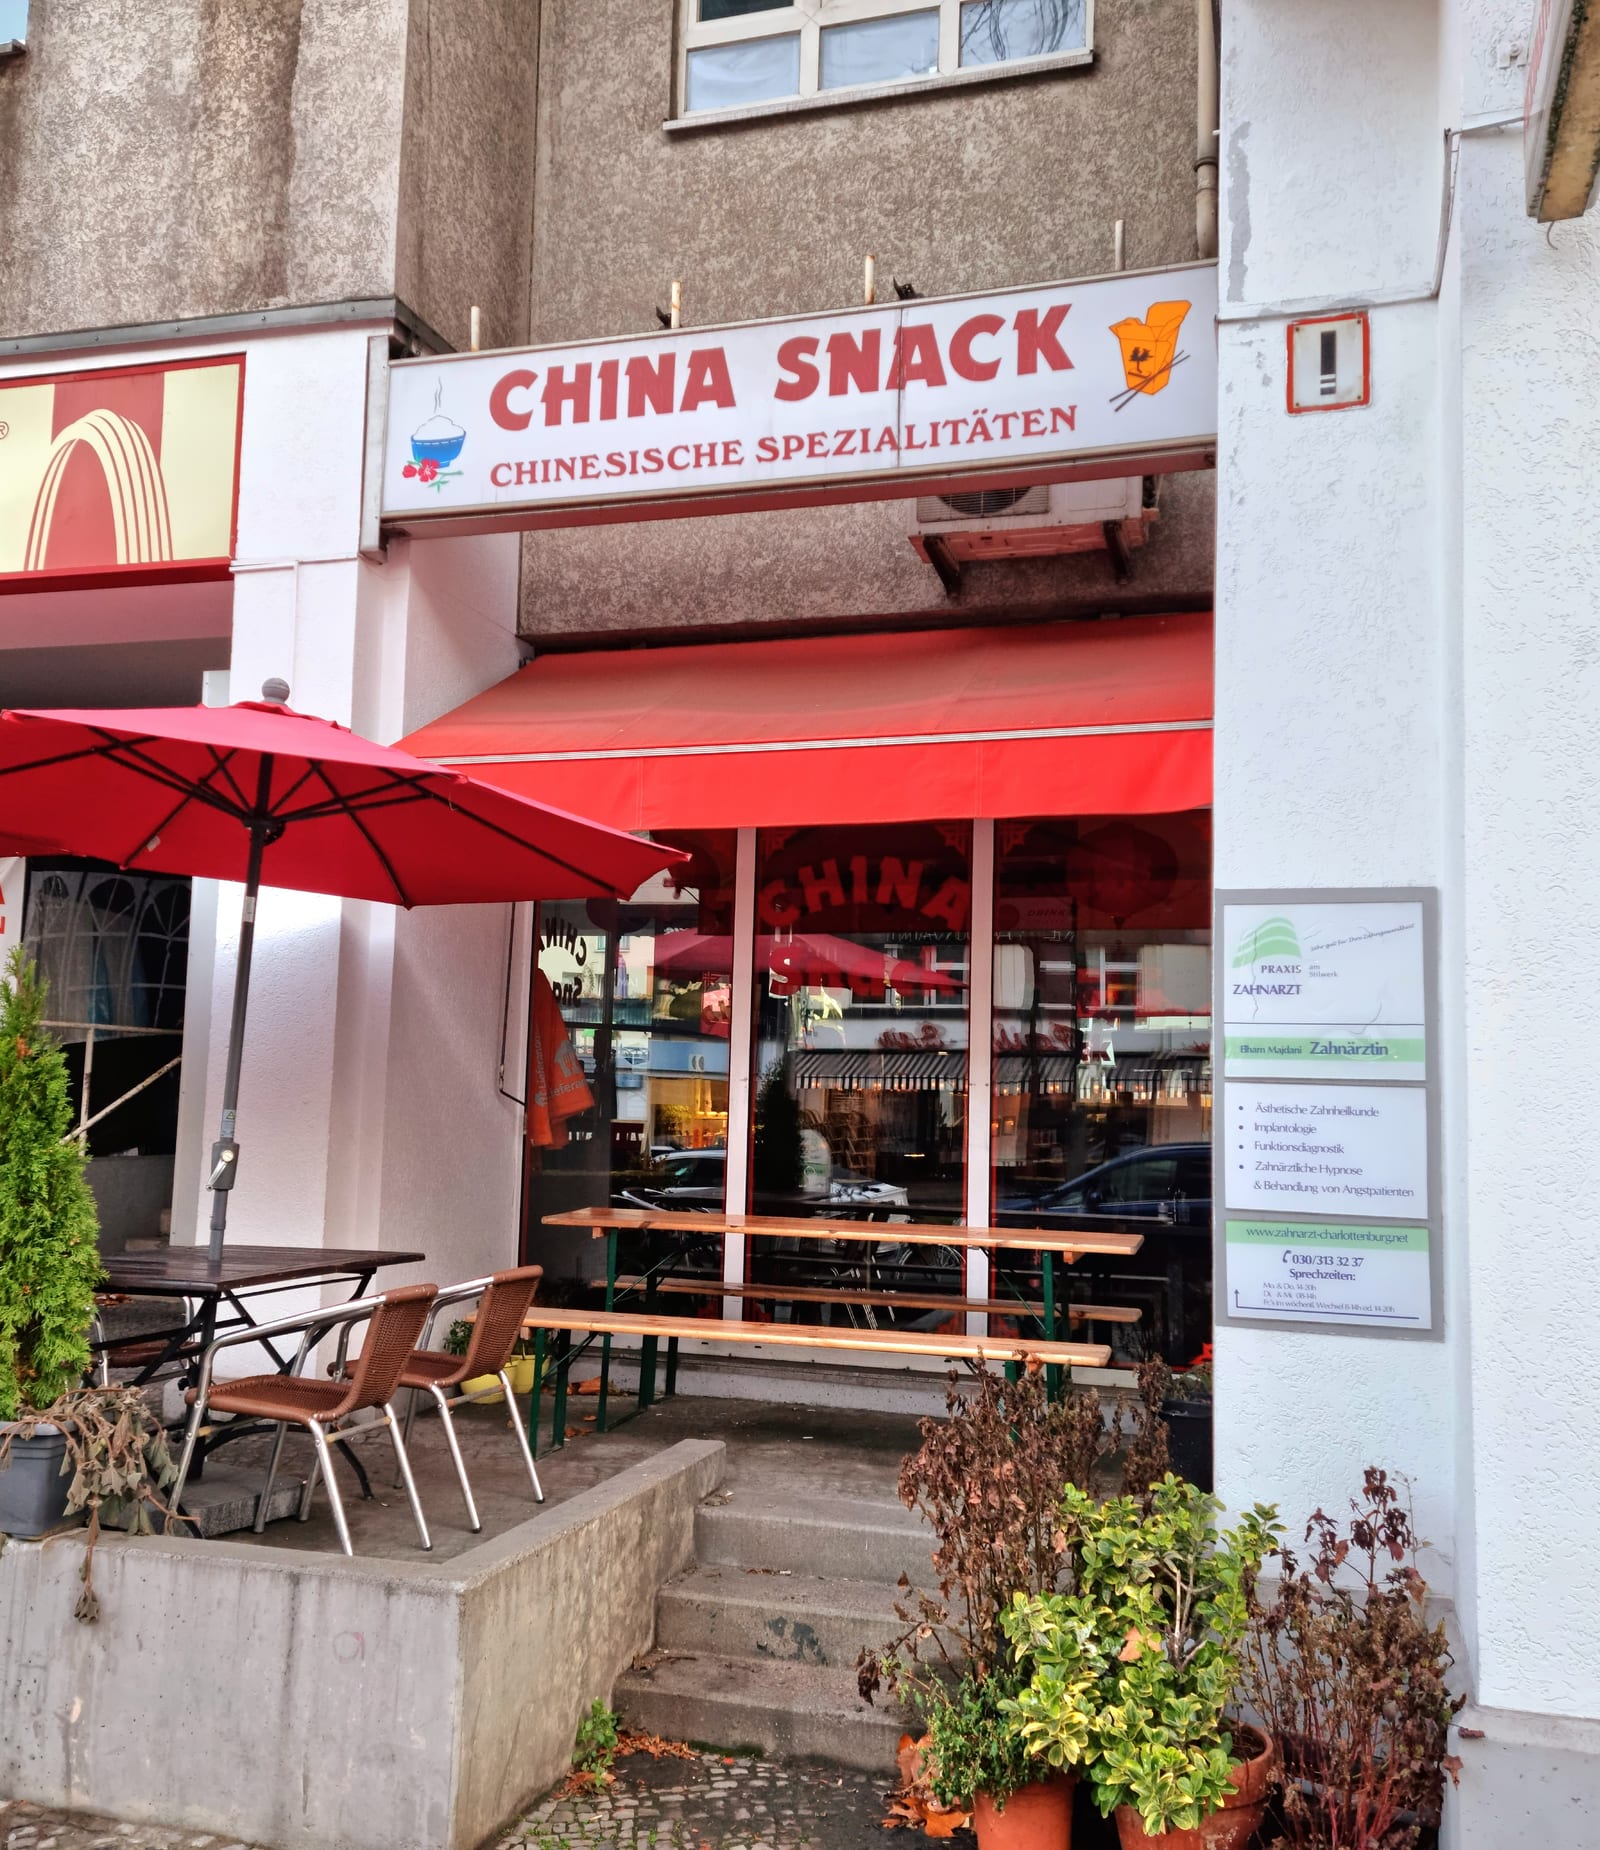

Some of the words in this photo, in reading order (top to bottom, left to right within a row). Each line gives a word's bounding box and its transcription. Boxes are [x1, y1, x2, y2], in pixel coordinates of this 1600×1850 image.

[488, 346, 737, 432] CHINA
[774, 303, 1076, 403] SNACK
[489, 439, 745, 488] CHINESISCHE
[755, 405, 1078, 463] SPEZIALITÄTEN
[758, 855, 971, 931] CHINA
[1261, 964, 1302, 974] PRAXIS
[1233, 984, 1302, 995] ZAHNARZT
[1267, 1044, 1302, 1056] Majdani
[1309, 1041, 1389, 1056] Zahnärztin
[1255, 1102, 1308, 1115] Ästhetische
[1310, 1105, 1380, 1117] Zahnheilkunde
[1254, 1122, 1317, 1136] Implantologie
[1254, 1141, 1345, 1154] Funktionsdiagnostik
[1255, 1161, 1317, 1174] Zahnärztliche
[1319, 1164, 1363, 1176] Hypnose
[1254, 1181, 1262, 1190] &
[1264, 1181, 1319, 1194] Behandlung
[1322, 1186, 1340, 1194] von
[1342, 1185, 1414, 1198] Angstpatienten
[1246, 1227, 1409, 1244] www.zahnarzt-charlottenburg.net
[1292, 1254, 1334, 1266] 030/313
[1337, 1256, 1349, 1267] 32
[1351, 1257, 1364, 1267] 37
[1289, 1268, 1356, 1281] Sprechzeiten:
